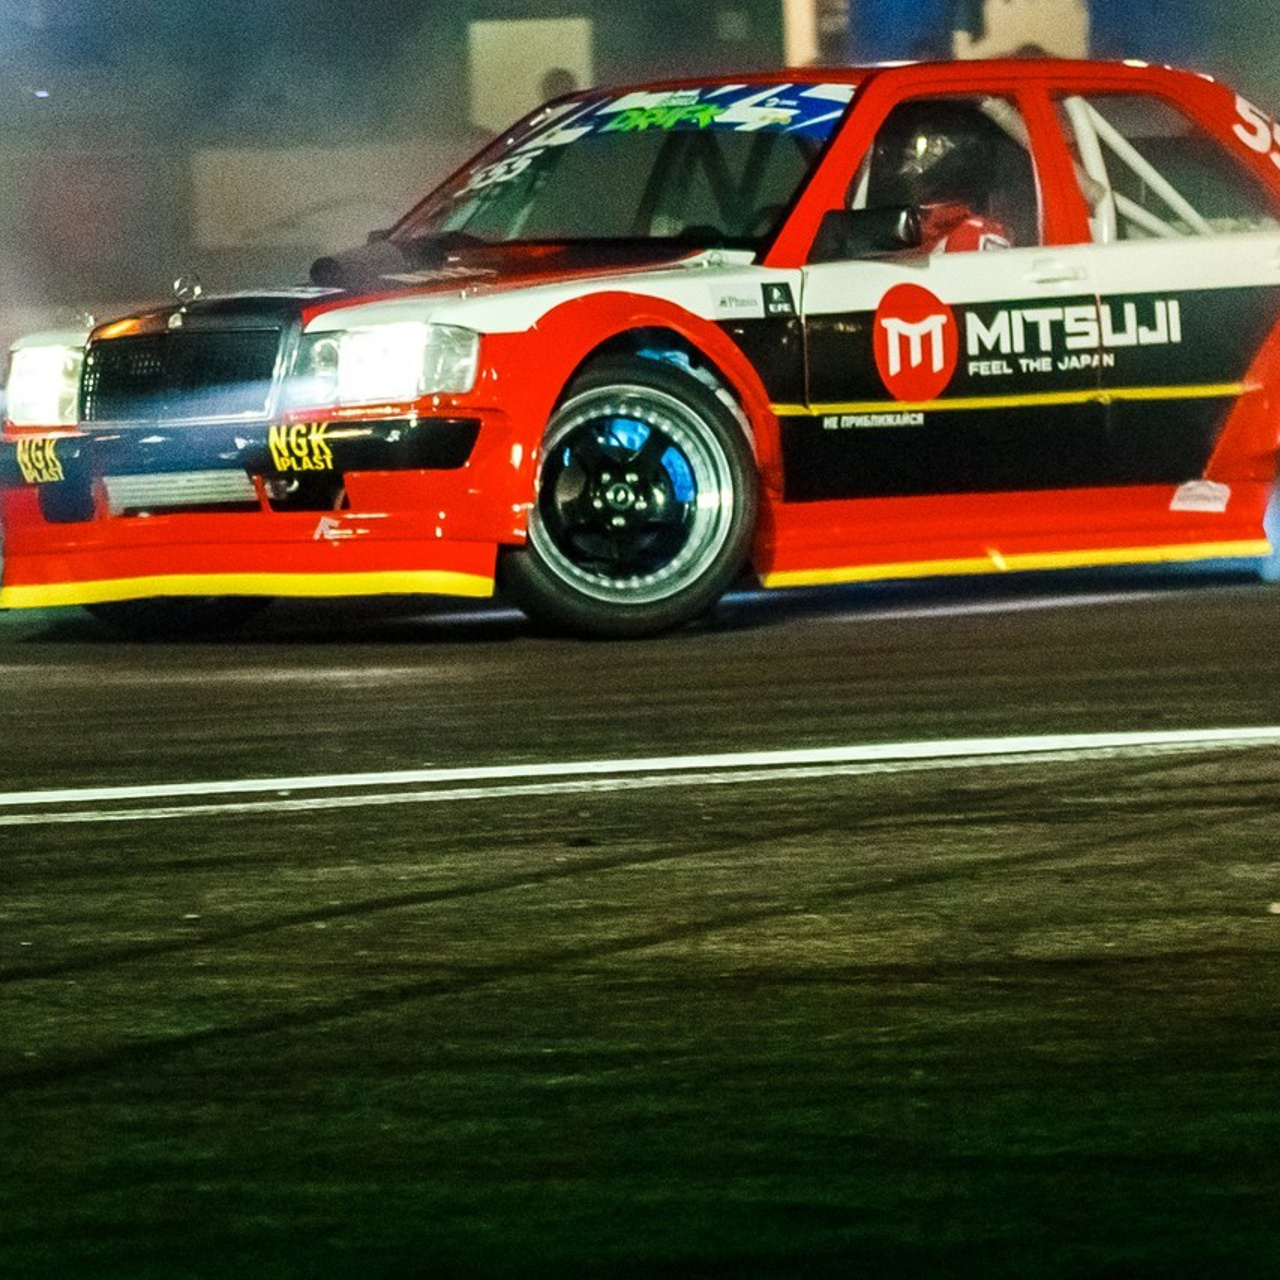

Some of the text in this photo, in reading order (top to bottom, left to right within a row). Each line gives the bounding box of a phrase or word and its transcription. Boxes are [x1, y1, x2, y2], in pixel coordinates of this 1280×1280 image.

[965, 300, 1182, 355] MITSUJI
[968, 353, 1115, 376] FEEL THE JAPAN
[16, 437, 62, 483] NGK
[269, 422, 331, 471] NGK
[281, 455, 334, 471] PLAST
[25, 467, 65, 484] PLAST
